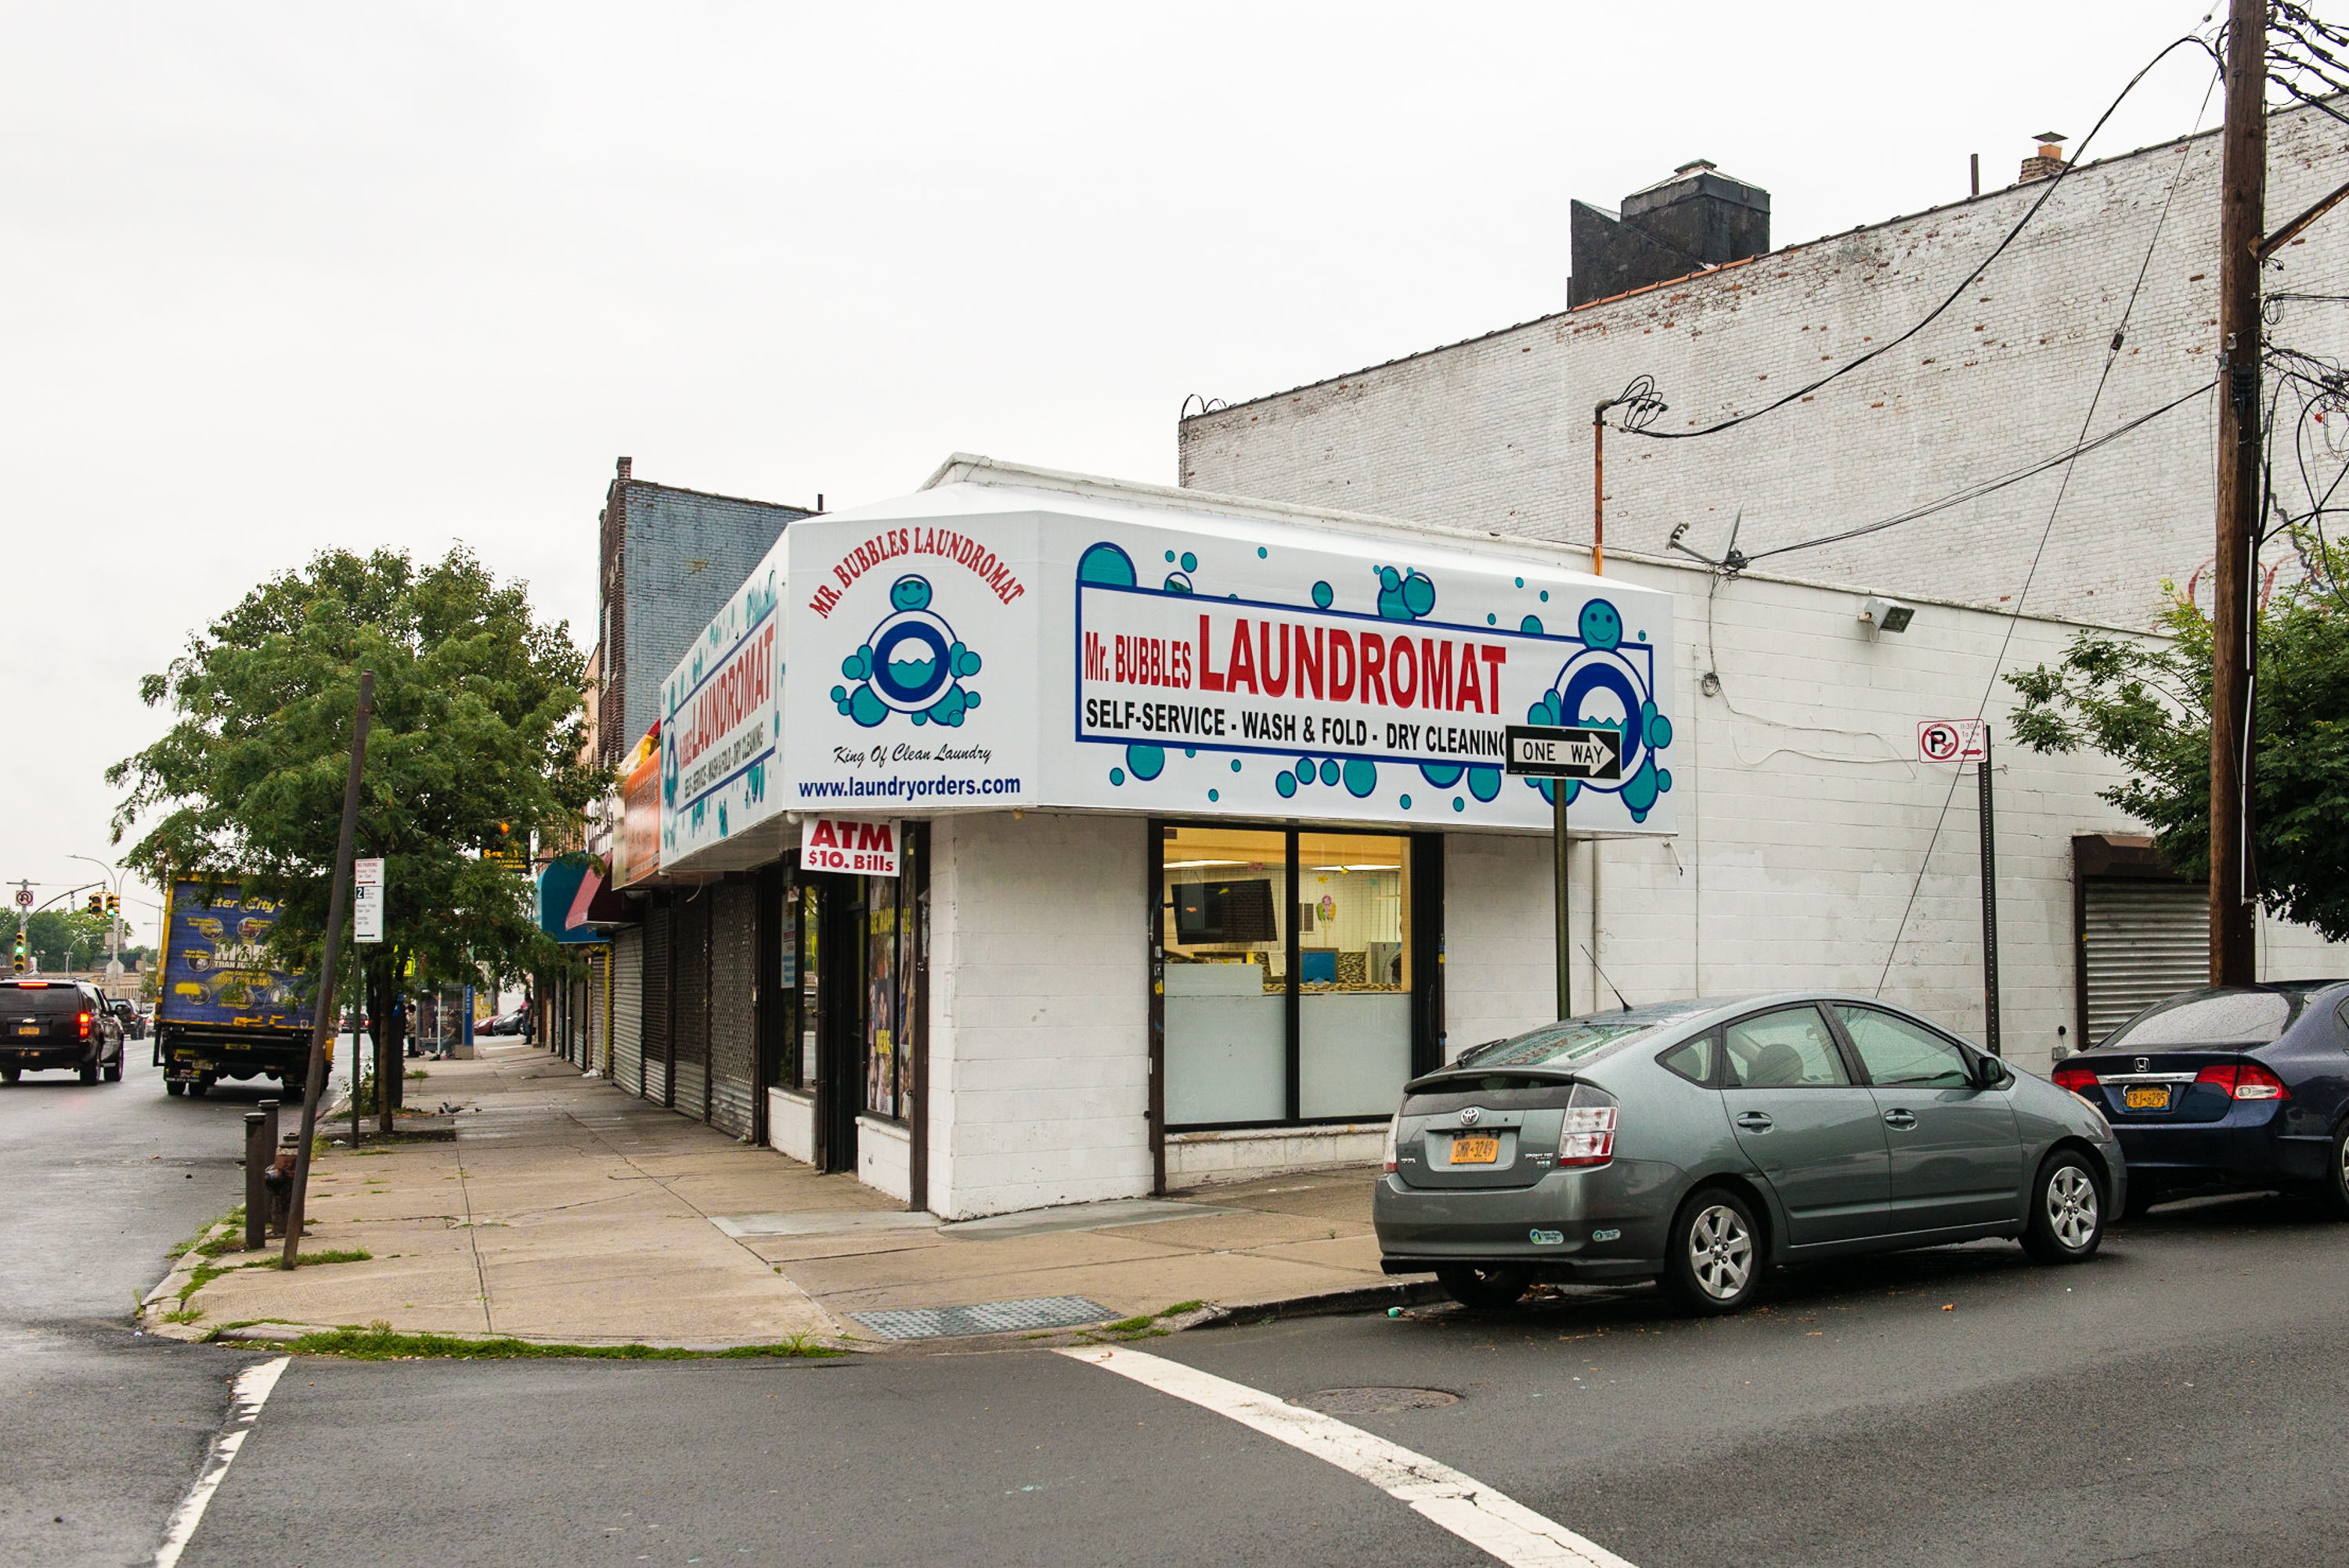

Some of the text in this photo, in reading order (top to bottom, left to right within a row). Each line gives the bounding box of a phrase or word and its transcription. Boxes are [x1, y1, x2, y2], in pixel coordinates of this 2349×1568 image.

[809, 526, 1025, 619] MR. BUBBLES LAUNDROMAT
[1085, 615, 1506, 715] Mr. BUBBLES LAUNDROMAT
[693, 622, 774, 761] LAUNDROMAT
[1085, 699, 1225, 737] SELF-SERVICE
[1242, 710, 1297, 742] WASH
[1303, 717, 1315, 743] &
[1322, 718, 1368, 747] FOLD
[1386, 720, 1420, 752] DRY
[833, 743, 993, 767] King Of Clean Laundry
[1523, 741, 1604, 764] ONE WAY
[799, 774, 1021, 801] www.laundryorders.com
[810, 819, 894, 852] ATM
[808, 850, 894, 873] $10. Bills
[357, 887, 363, 899] 2
